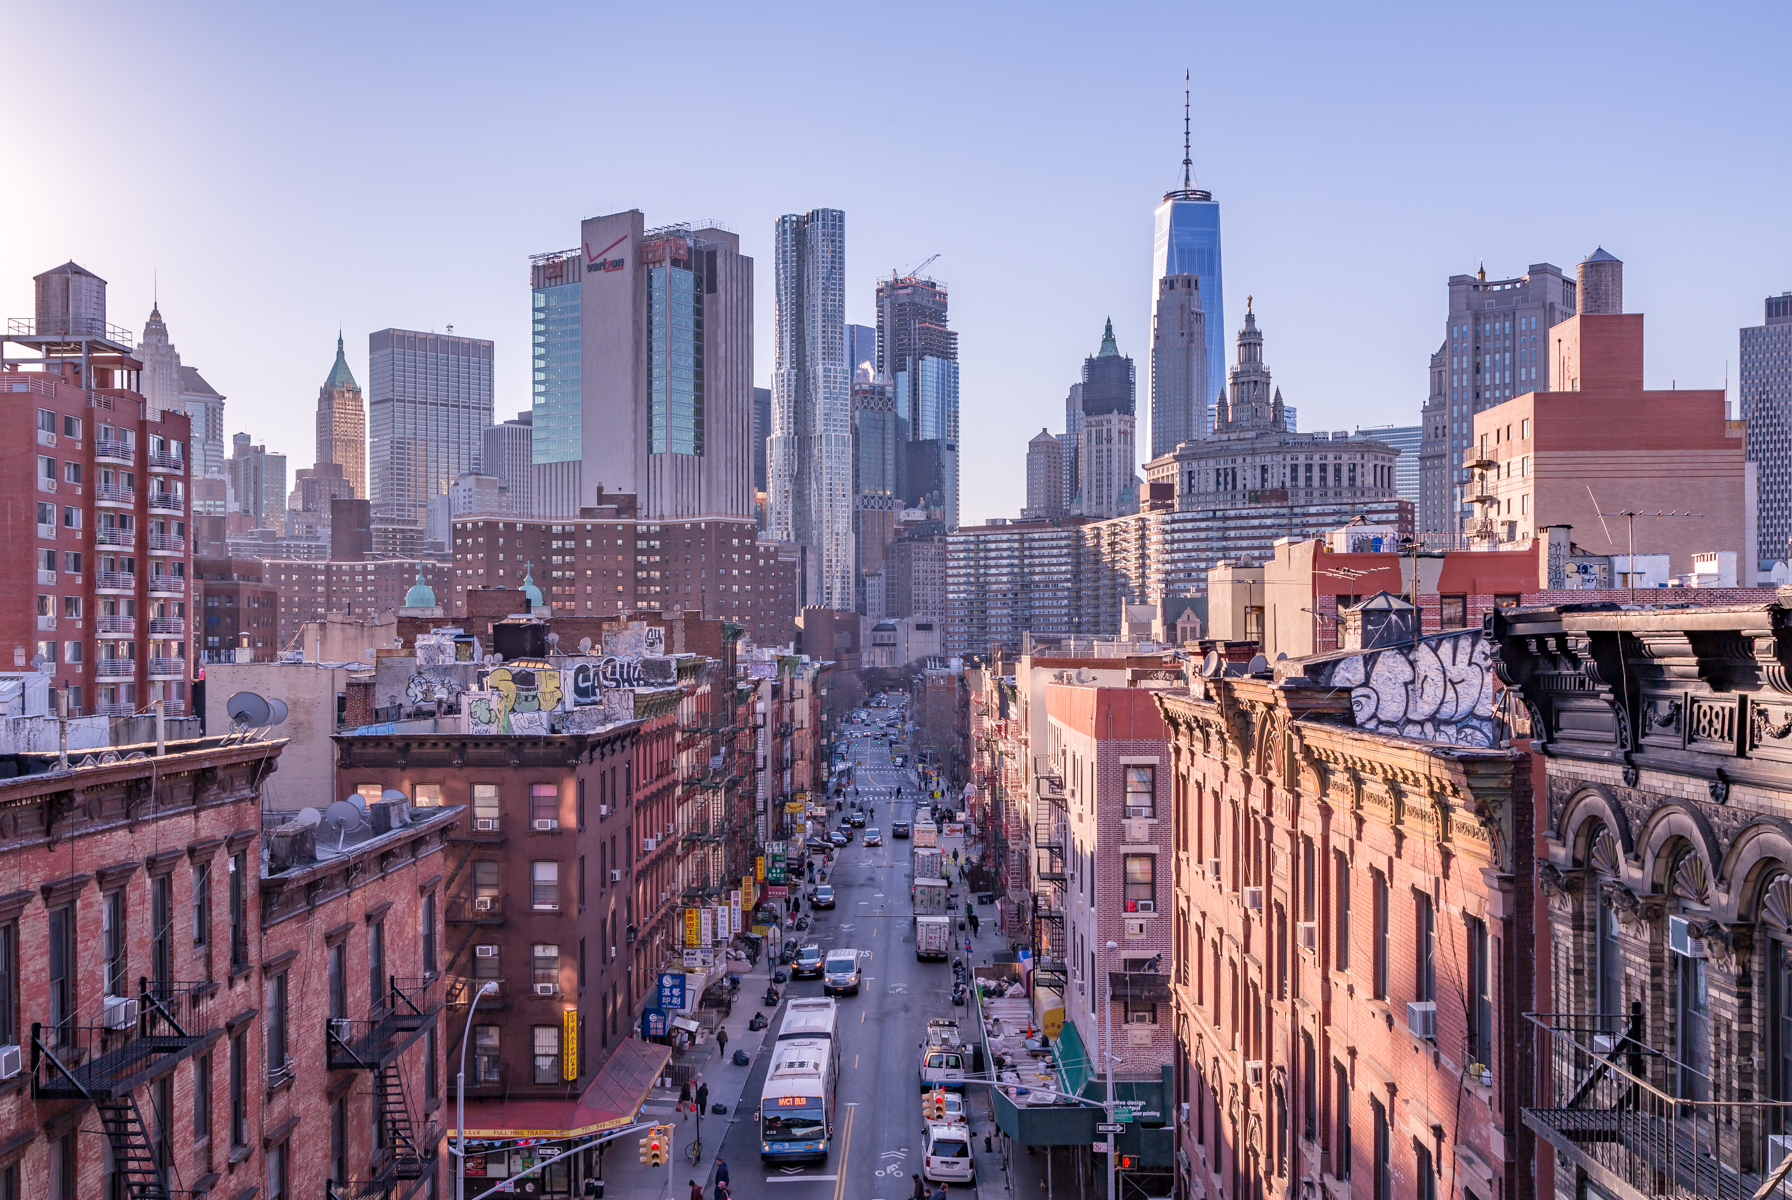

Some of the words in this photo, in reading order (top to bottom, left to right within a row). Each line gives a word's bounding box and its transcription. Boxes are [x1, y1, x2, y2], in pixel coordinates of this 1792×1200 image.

[587, 258, 625, 273] verizon
[1692, 702, 1731, 741] 1891
[795, 1097, 807, 1105] BUS
